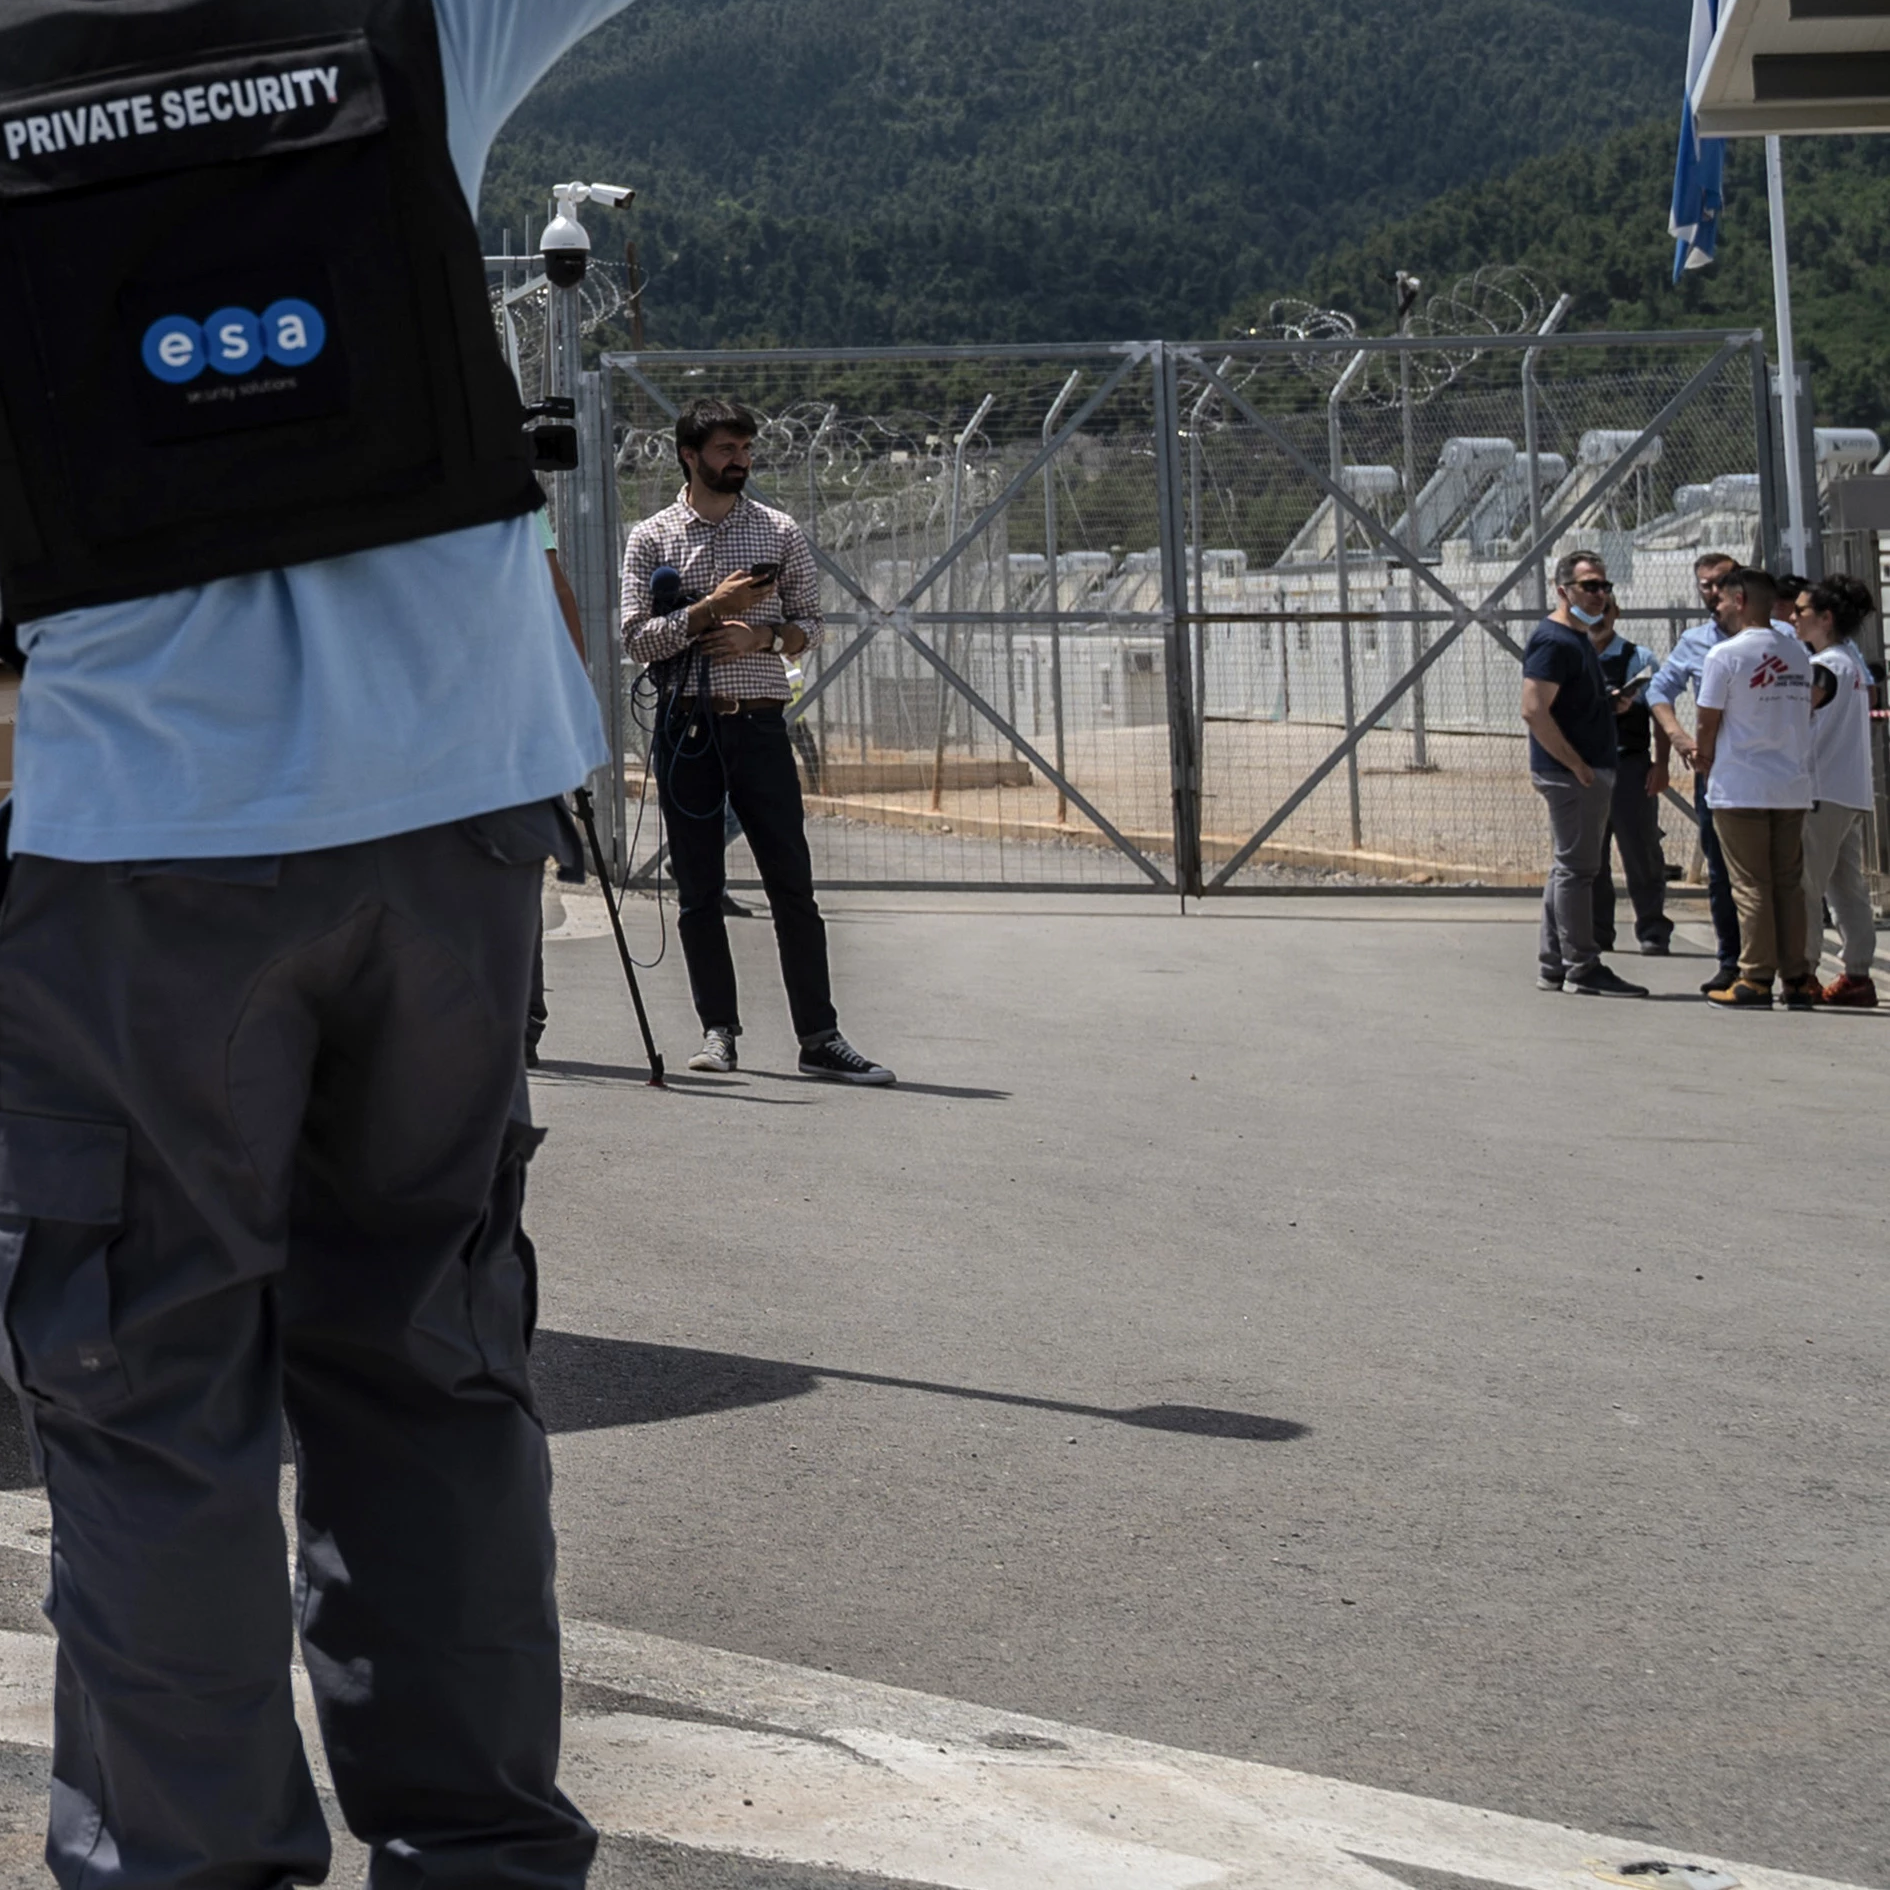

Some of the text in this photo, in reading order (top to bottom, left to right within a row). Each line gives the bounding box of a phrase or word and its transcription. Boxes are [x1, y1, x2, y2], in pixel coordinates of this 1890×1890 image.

[4, 66, 340, 159] PRIVATE SECURITY
[158, 313, 308, 367] esa
